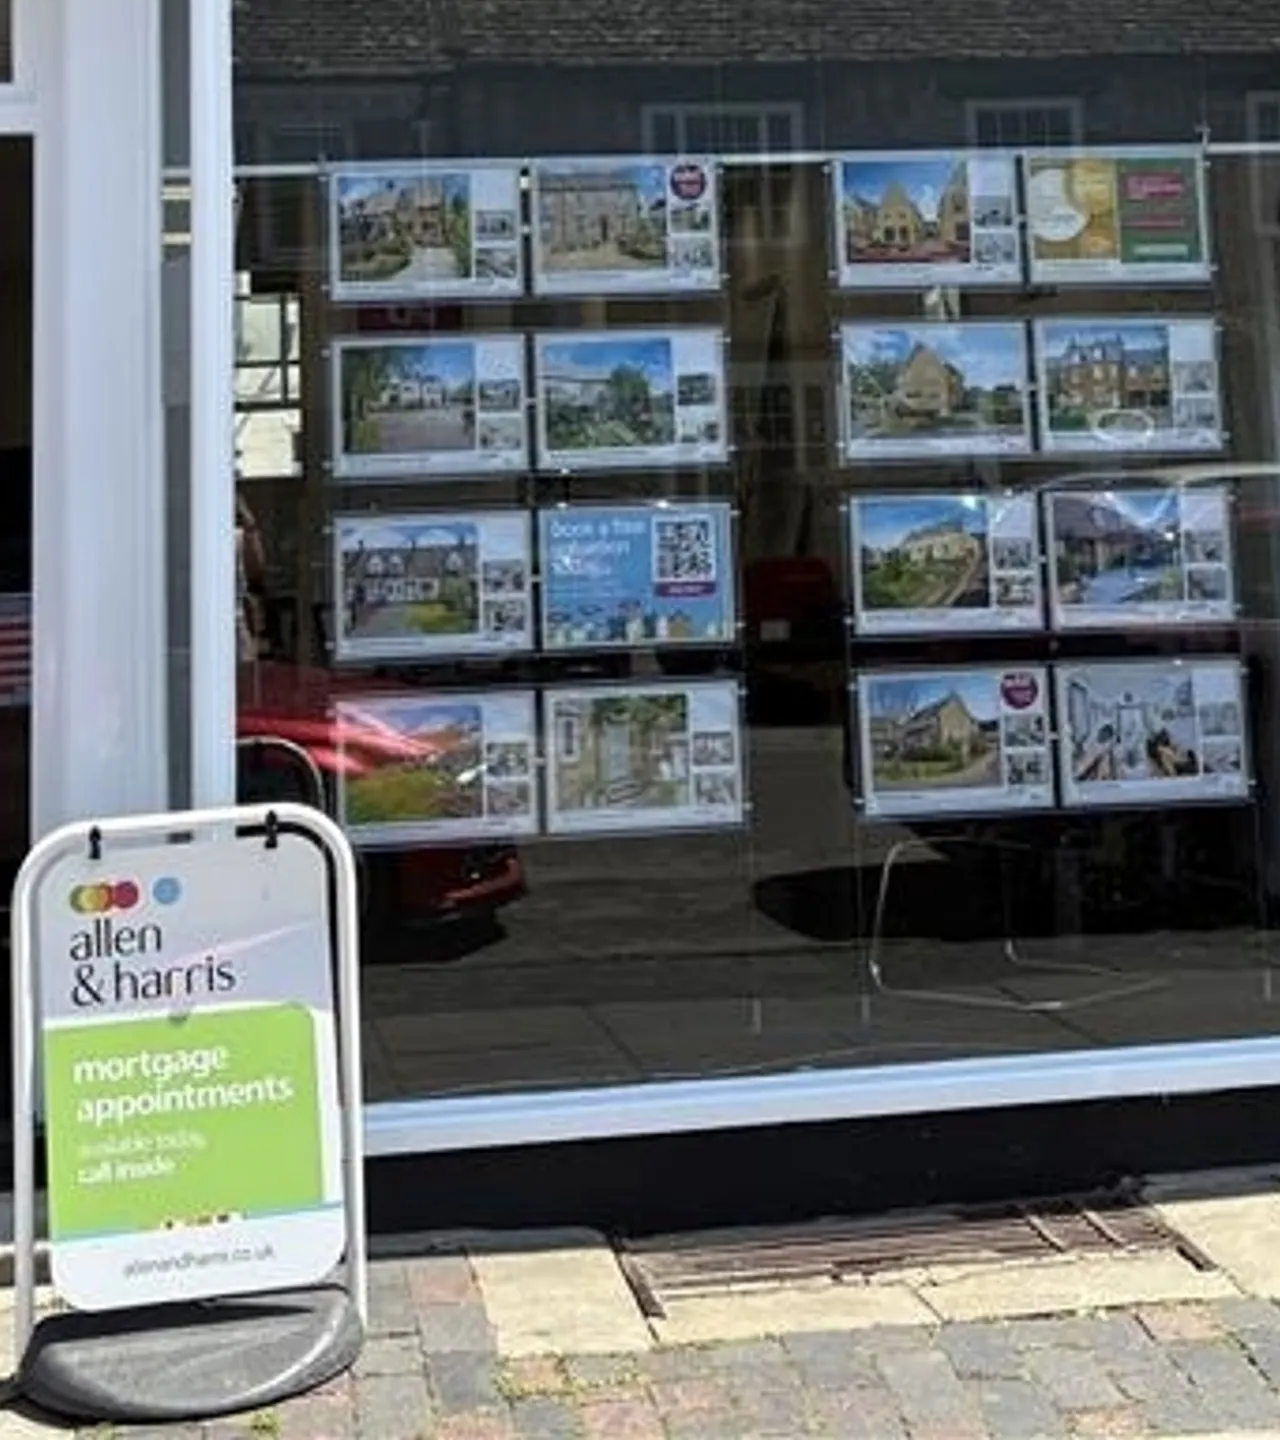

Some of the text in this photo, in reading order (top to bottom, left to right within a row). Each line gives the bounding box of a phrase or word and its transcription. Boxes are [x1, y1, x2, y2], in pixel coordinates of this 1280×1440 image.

[70, 918, 162, 961] allen
[70, 956, 237, 1007] & harris
[74, 1046, 228, 1083] mortgage
[77, 1076, 292, 1126] appointments
